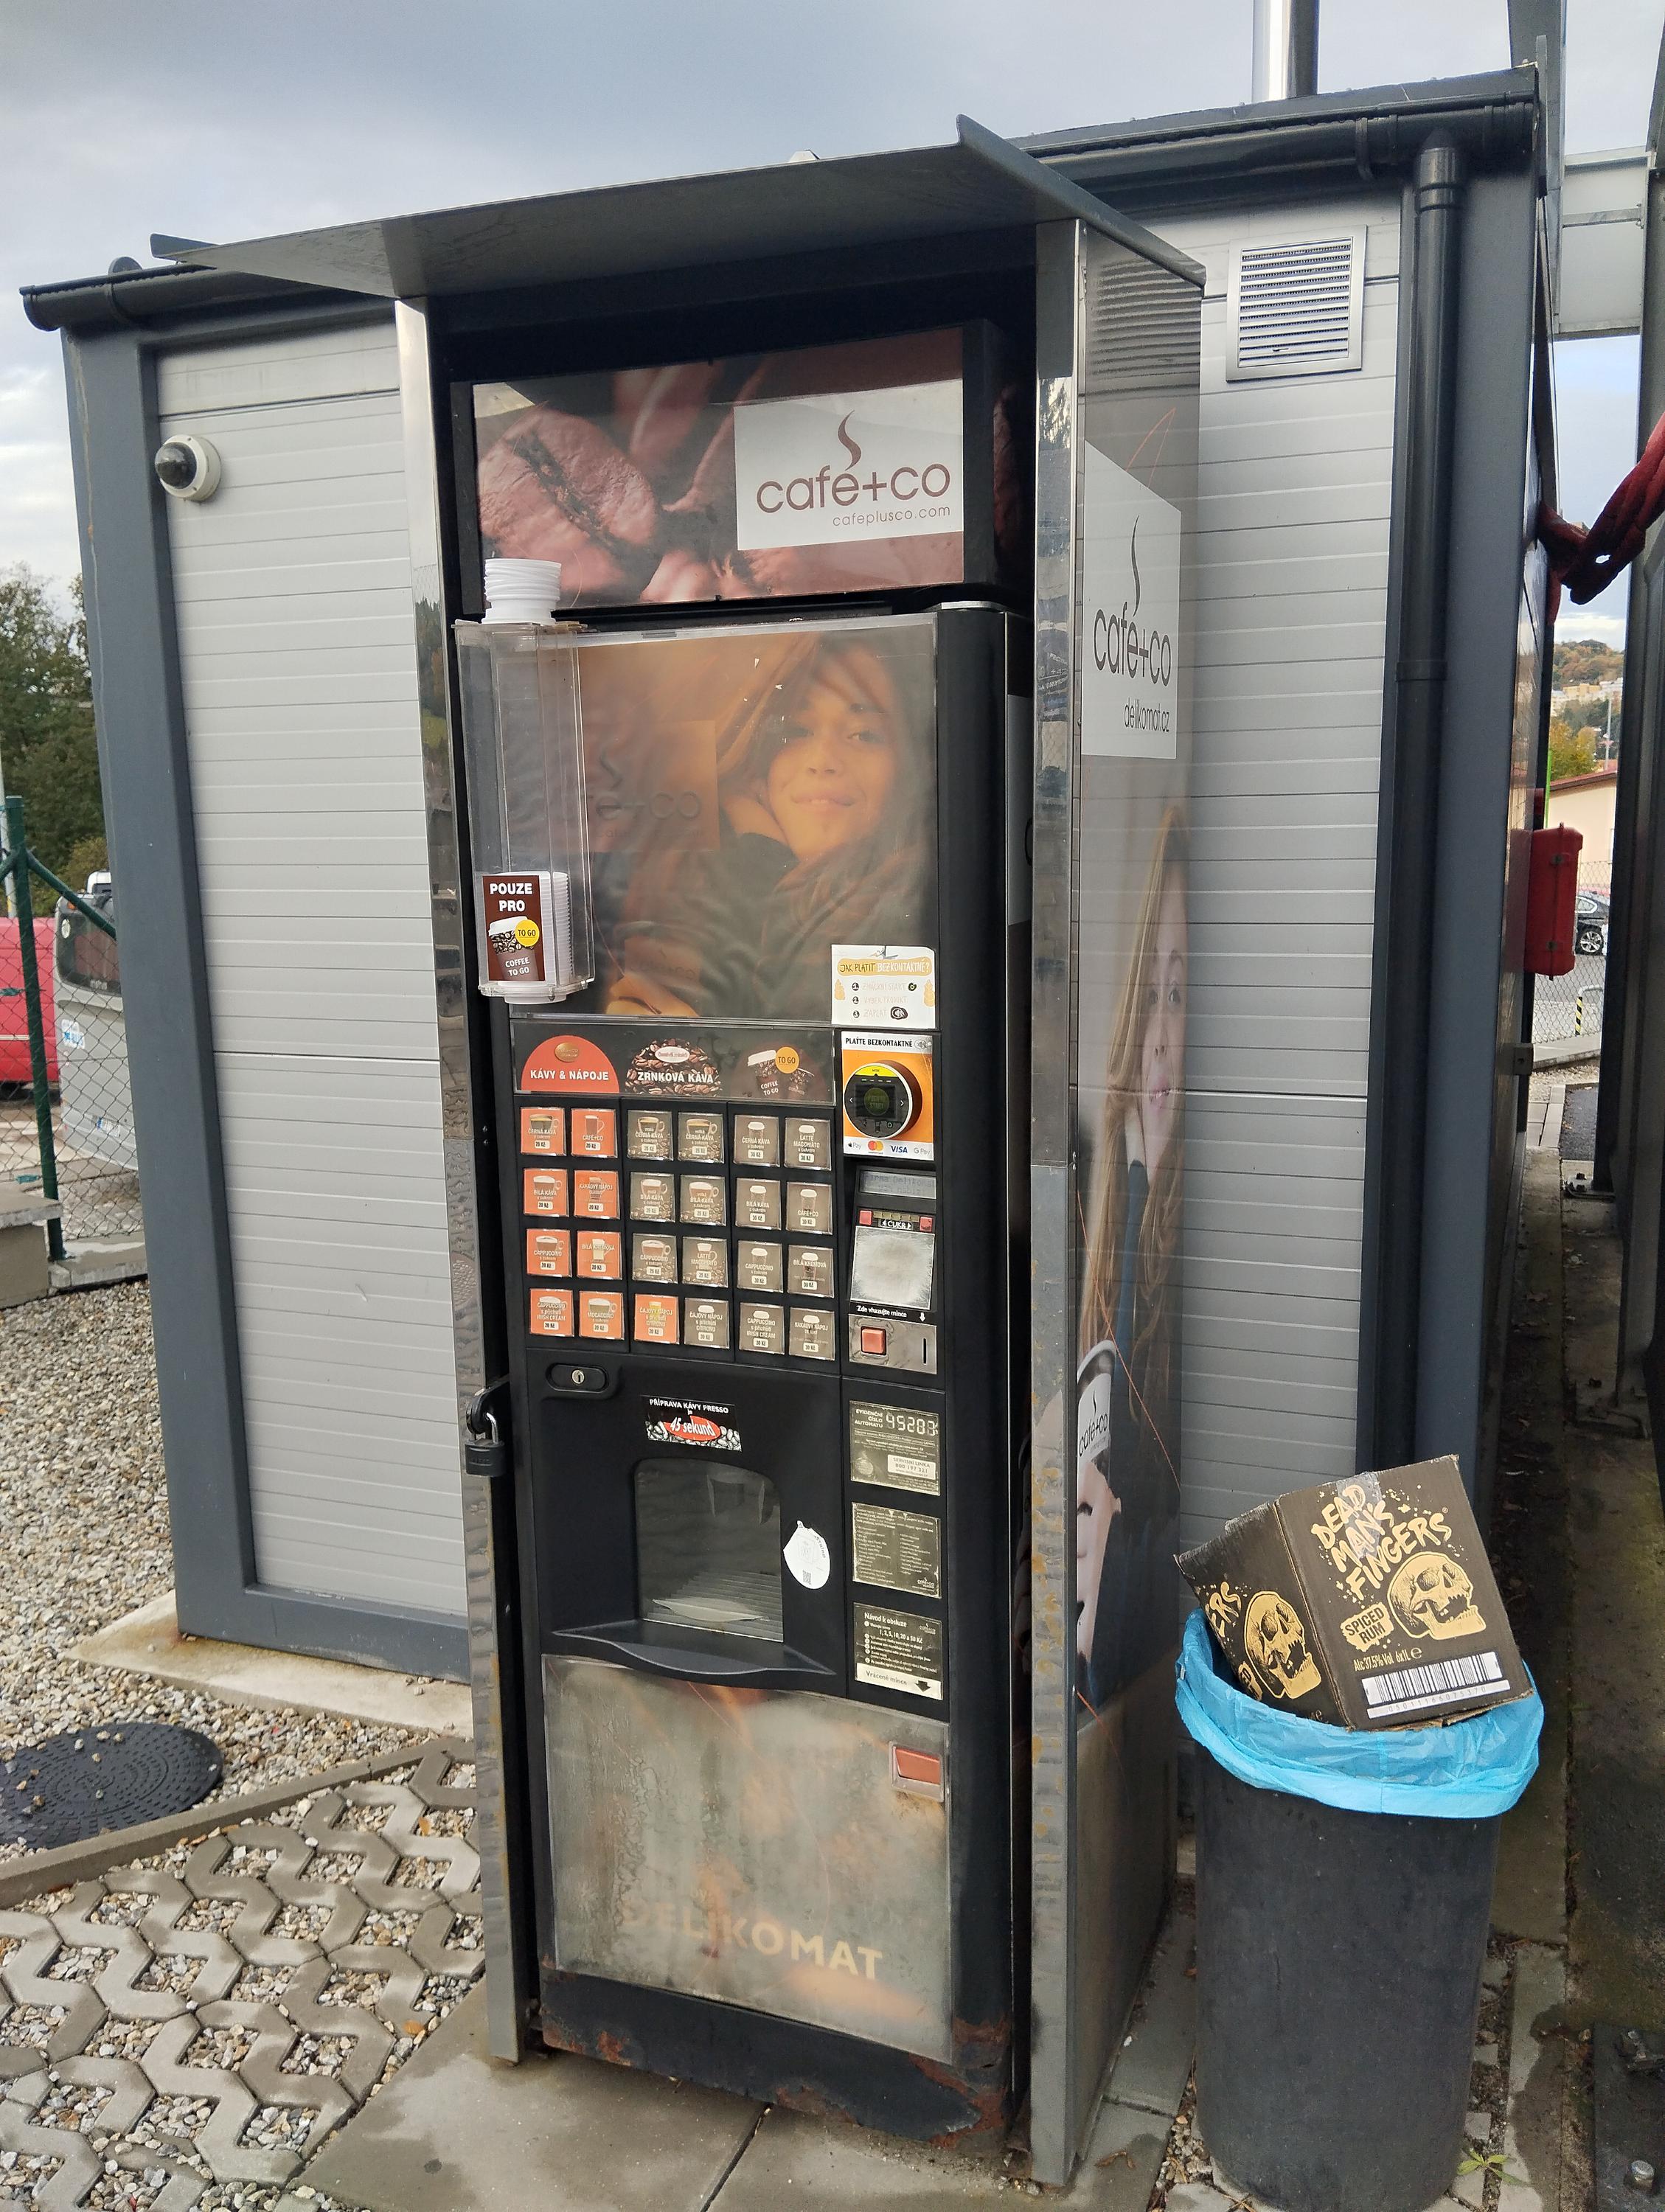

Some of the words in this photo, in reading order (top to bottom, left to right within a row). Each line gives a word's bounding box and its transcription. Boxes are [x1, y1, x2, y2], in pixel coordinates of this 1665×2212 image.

[832, 506, 950, 526] cafeplusco.com
[1124, 698, 1170, 732] delikomat.cz
[490, 883, 532, 895] POUZE
[498, 900, 526, 912] PRO
[527, 929, 536, 937] GO
[505, 957, 530, 967] COFFEE
[840, 964, 853, 973] JAK
[855, 963, 876, 973] PLATIT
[519, 967, 529, 975] GO
[530, 1068, 555, 1079] KÁVY
[559, 1070, 566, 1079] &
[569, 1069, 609, 1081] NÁPOJE
[637, 1070, 685, 1082] ZRNKOVÁ
[688, 1071, 714, 1084] KÁVA
[760, 1082, 779, 1090] COFFEE
[890, 1145, 908, 1153] VISA
[887, 1220, 906, 1229] CUKR
[649, 1397, 683, 1408] PŘÍPRAVA
[683, 1401, 701, 1411] KÁVY
[703, 1404, 729, 1413] PRESSO
[855, 1408, 883, 1417] EVIDENČNÍ
[670, 1416, 682, 1432] 45
[683, 1419, 716, 1436] sekund
[855, 1419, 883, 1428] AUTOMATU
[1310, 1484, 1366, 1549] DEAD
[1331, 1500, 1394, 1573] MAN'S
[1346, 1512, 1452, 1601] FINGERS
[864, 1612, 882, 1621] Návod
[886, 1617, 907, 1627] obsluze
[1344, 1608, 1385, 1637] SPICED
[1358, 1623, 1386, 1644] RUM
[890, 1676, 907, 1686] mince
